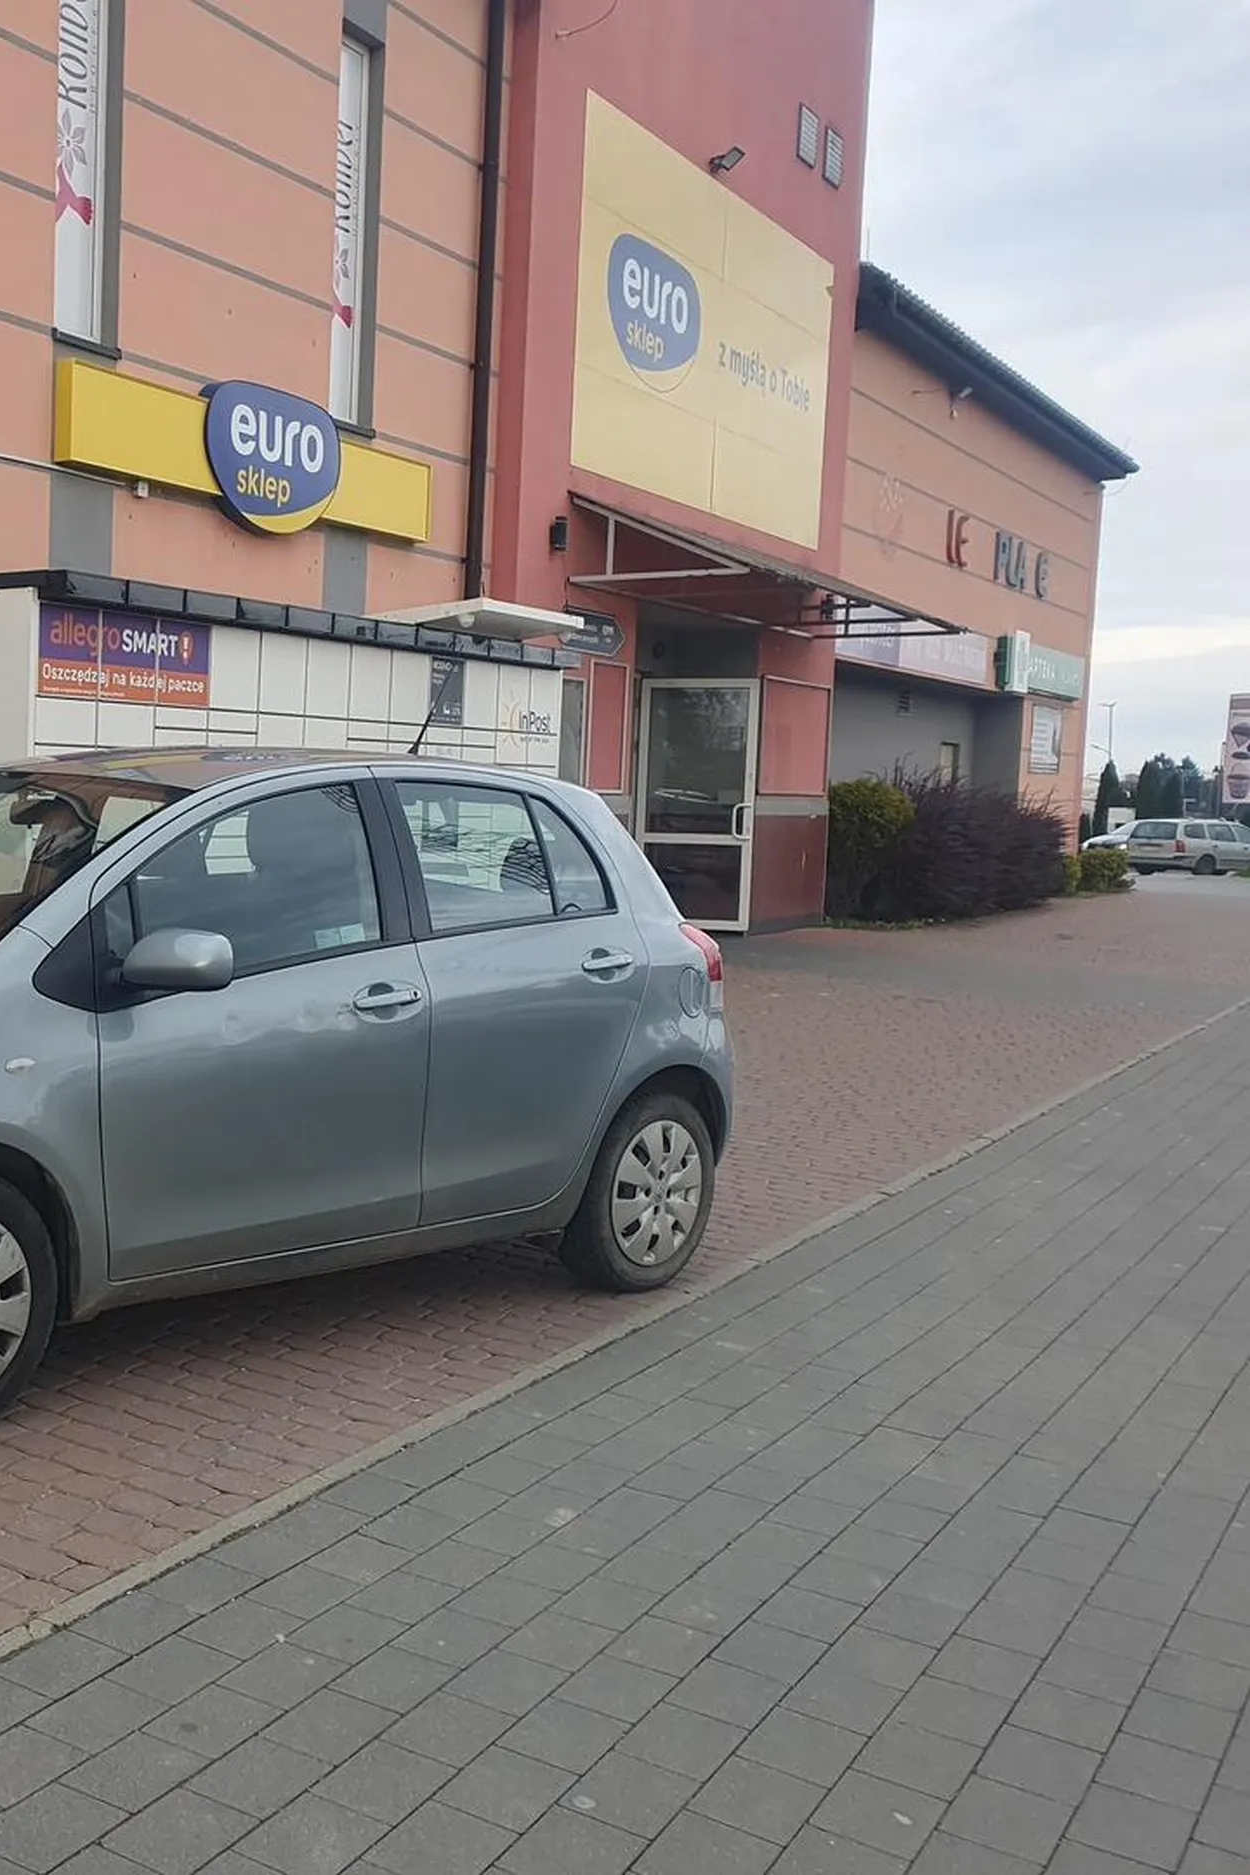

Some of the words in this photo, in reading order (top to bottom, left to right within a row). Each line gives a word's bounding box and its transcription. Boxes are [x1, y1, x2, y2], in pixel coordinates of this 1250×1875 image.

[622, 258, 688, 333] euro
[626, 320, 664, 361] sklep
[770, 369, 777, 392] o
[231, 404, 324, 473] euro
[236, 465, 291, 507] sklep
[50, 611, 120, 657] allegro
[42, 662, 110, 688] Oszczędzaj
[112, 672, 126, 686] na
[518, 710, 551, 734] InPost
